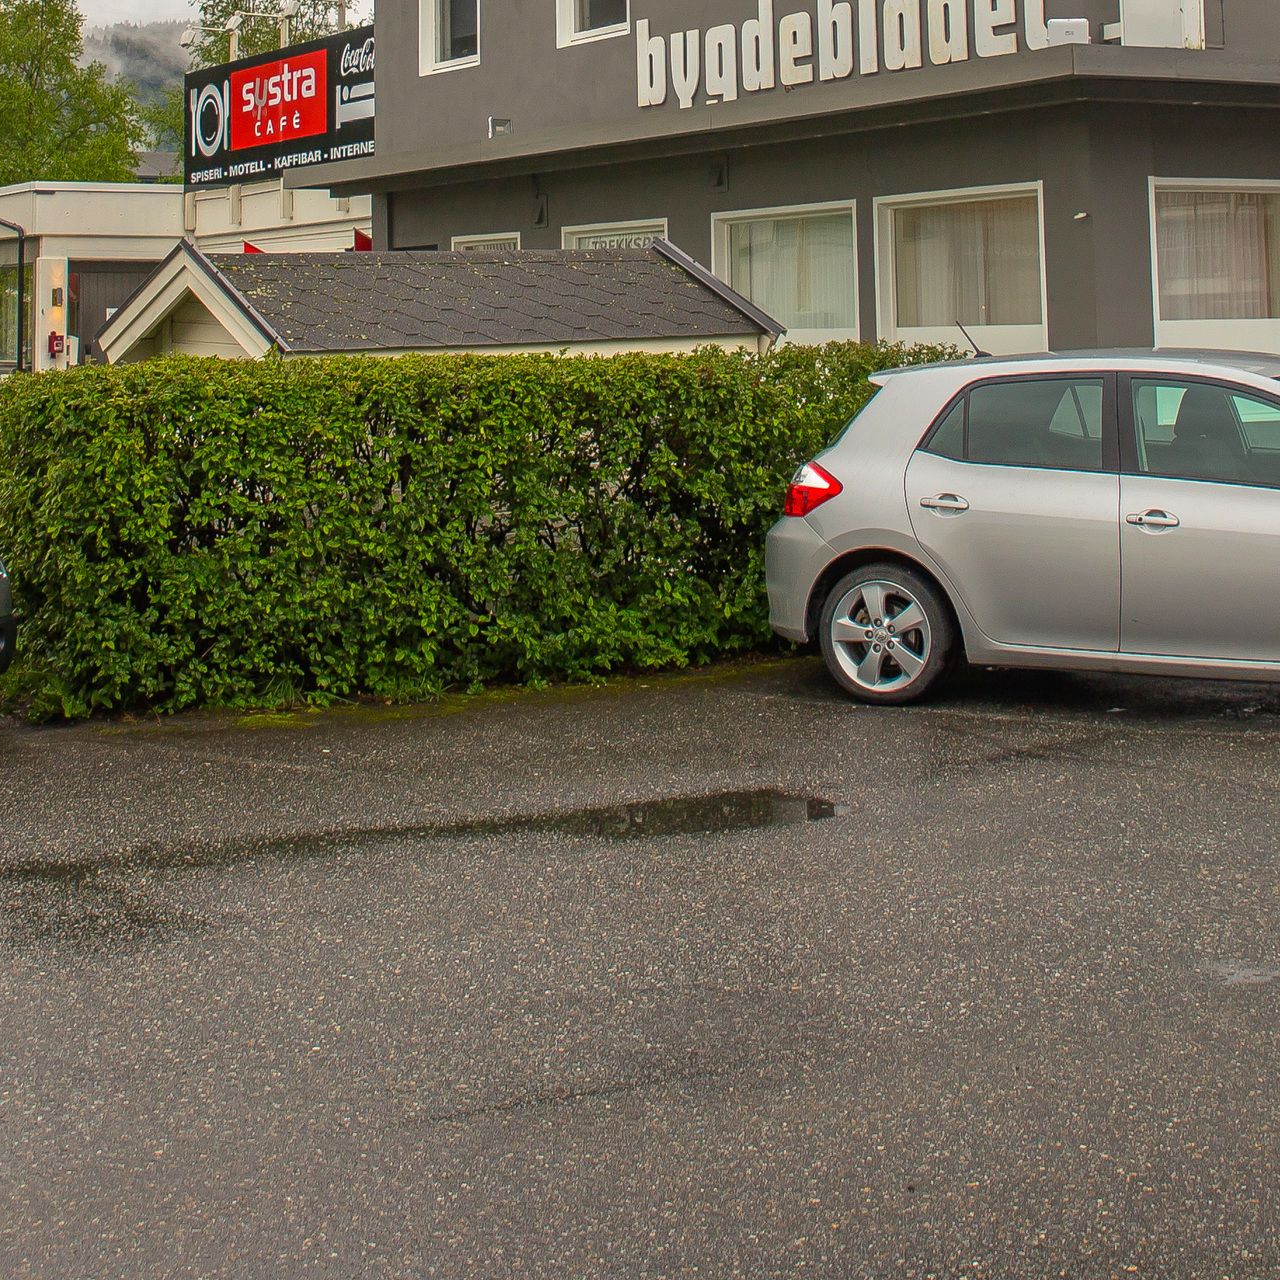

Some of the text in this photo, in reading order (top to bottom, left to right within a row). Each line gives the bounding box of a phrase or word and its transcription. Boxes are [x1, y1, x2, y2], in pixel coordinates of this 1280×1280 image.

[242, 63, 316, 121] systra
[190, 140, 375, 184] SPISERI MOTELL KAFFIBAR INTERNE
